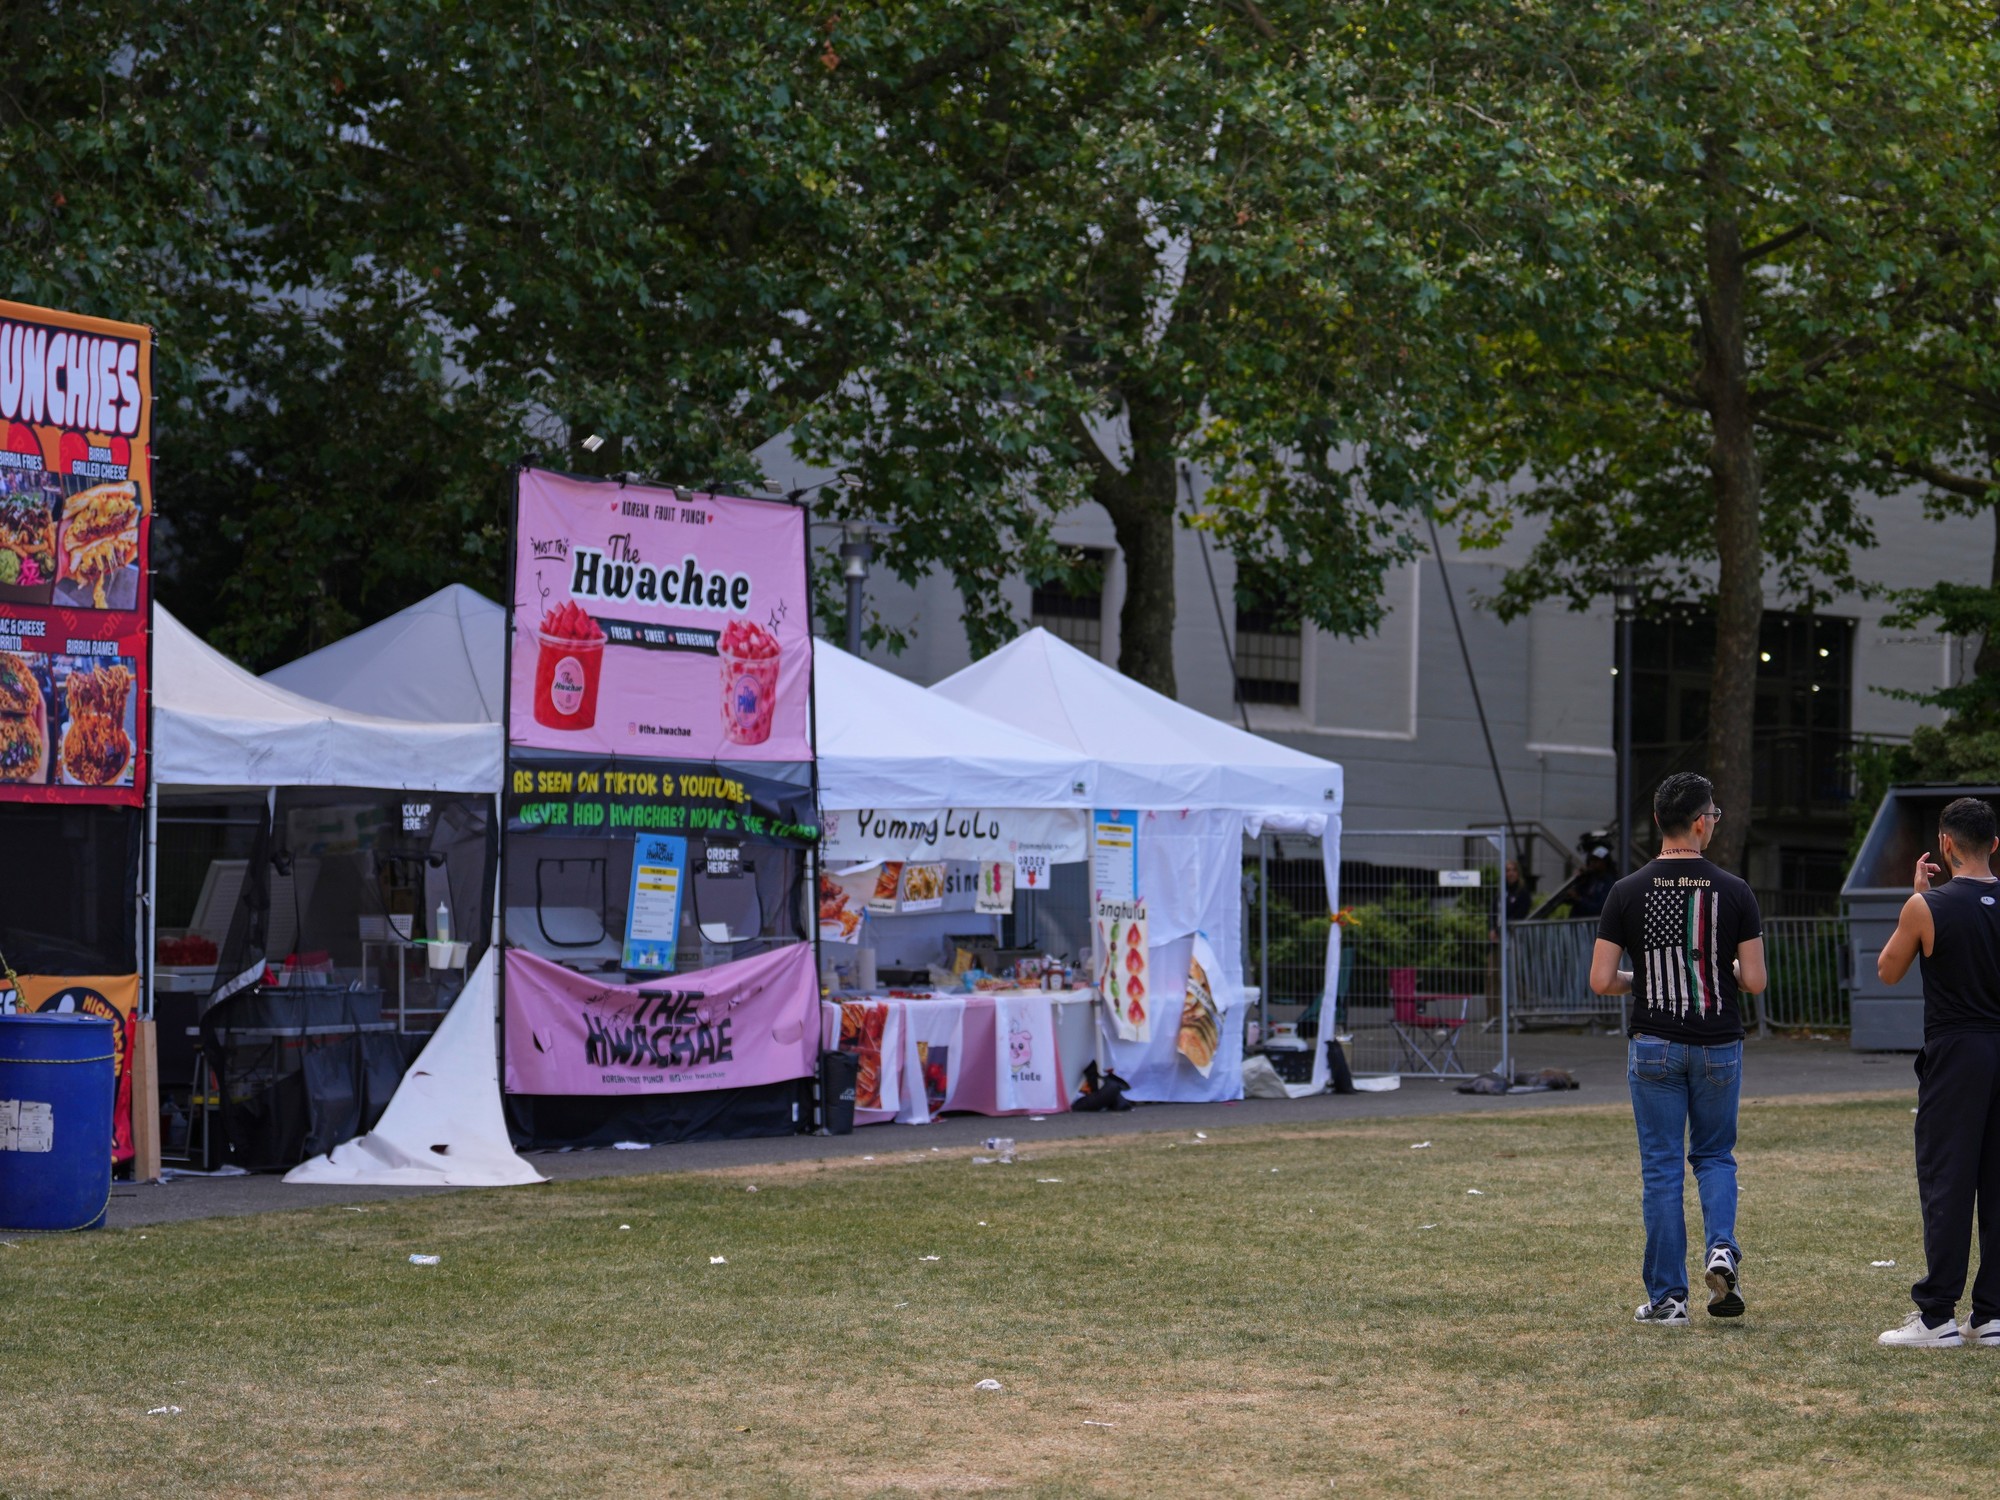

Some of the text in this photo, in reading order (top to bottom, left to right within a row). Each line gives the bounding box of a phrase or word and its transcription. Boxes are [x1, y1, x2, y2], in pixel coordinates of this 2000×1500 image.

[22, 454, 43, 471] FRIES
[88, 446, 112, 463] BIRRIA
[72, 460, 128, 480] GRILLED CHEESE
[621, 501, 706, 525] KOREAN FRUIT PUNCH
[533, 539, 554, 556] MUST
[608, 533, 641, 564] The
[571, 551, 749, 609] Hwachae
[17, 619, 46, 637] CHEESE
[610, 626, 715, 647] FRESH SWEET REFRESHING
[66, 639, 119, 657] BIRRIA RAMEN
[513, 770, 533, 793] AS
[537, 770, 573, 793] SEEN
[577, 771, 599, 793] ON
[604, 771, 658, 796] TIKTOK
[662, 774, 675, 797] &
[416, 804, 431, 817] UP
[520, 802, 568, 824] NEVER
[573, 802, 604, 826] HAD
[609, 802, 686, 829] HWACHAE?
[690, 807, 737, 830] NOW'S
[858, 809, 938, 846] Yummy
[707, 848, 739, 861] ORDER
[1017, 856, 1046, 867] ORDER
[707, 861, 729, 874] HERE
[1652, 876, 1711, 887] Viva Mexico
[632, 989, 705, 1026] THE
[582, 1012, 734, 1069] HWACHAE
